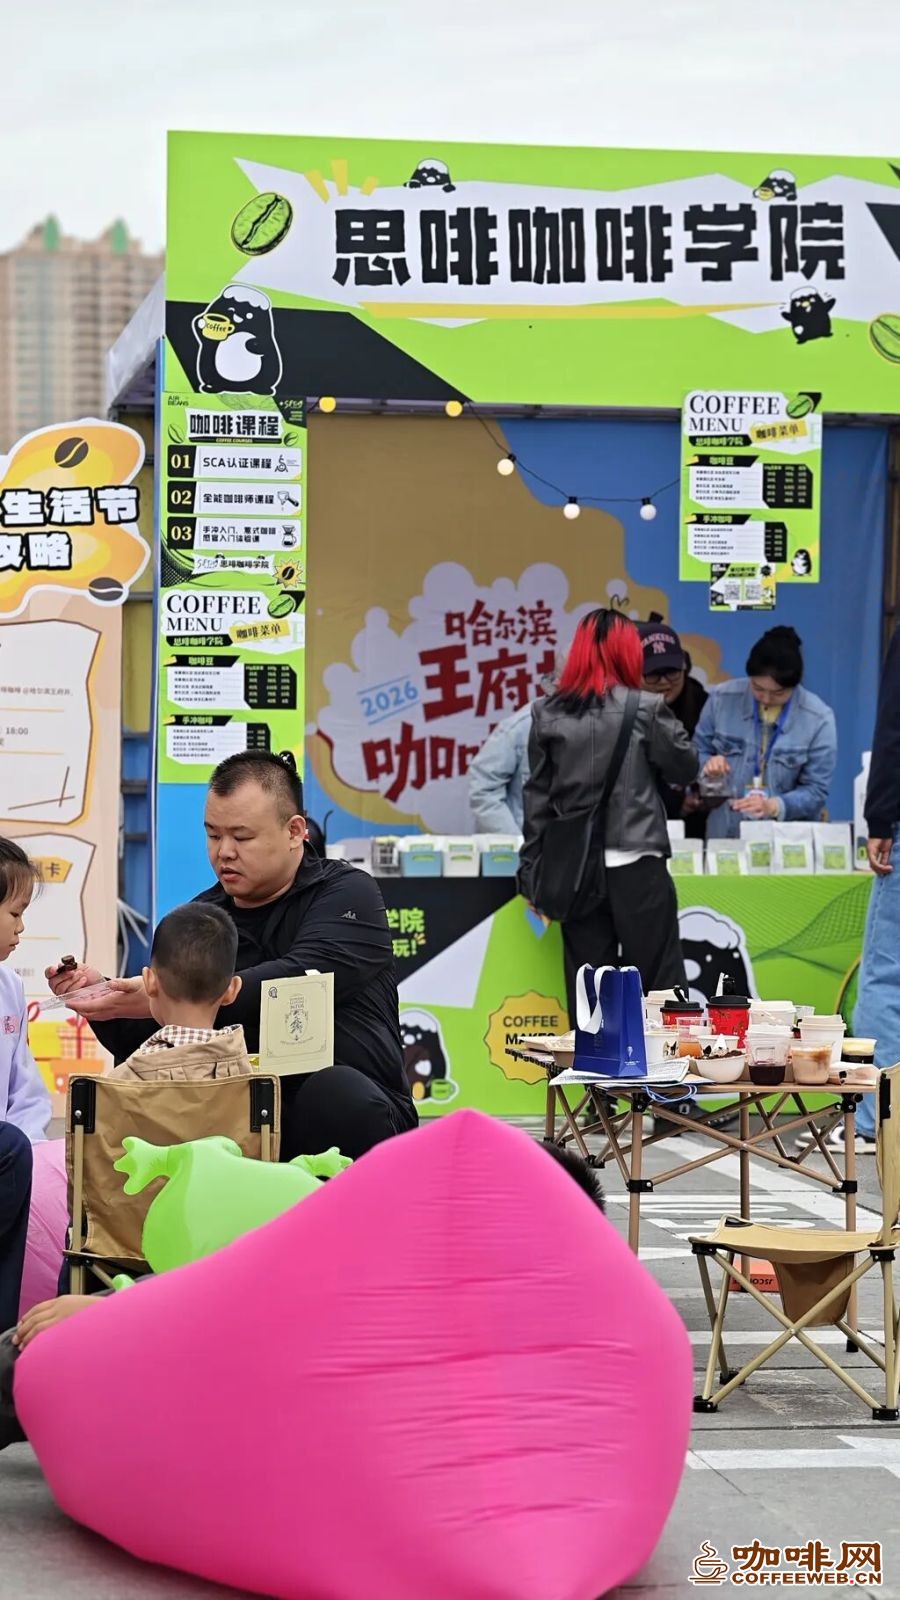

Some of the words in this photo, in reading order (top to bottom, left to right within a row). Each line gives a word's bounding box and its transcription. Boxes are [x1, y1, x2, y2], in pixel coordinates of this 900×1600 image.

[331, 201, 846, 287] 思啡咖啡学院
[206, 322, 227, 333] coffee
[689, 394, 780, 415] COFFEE
[190, 414, 279, 436] 咖啡课程
[689, 417, 743, 433] MENU
[755, 424, 799, 440] 咖啡菜单
[171, 454, 191, 469] 01
[203, 457, 272, 469] SCA认证课程
[171, 490, 192, 505] 02
[203, 493, 274, 505] 全能咖啡师课程
[1, 487, 139, 526] 生活节
[171, 526, 192, 541] 03
[166, 594, 261, 615] COFFEE
[166, 617, 224, 633] MENU
[444, 599, 557, 647] 哈尔滨
[235, 623, 282, 640] 咖啡菜单
[360, 680, 419, 719] 2026
[503, 1015, 559, 1028] COFFEE
